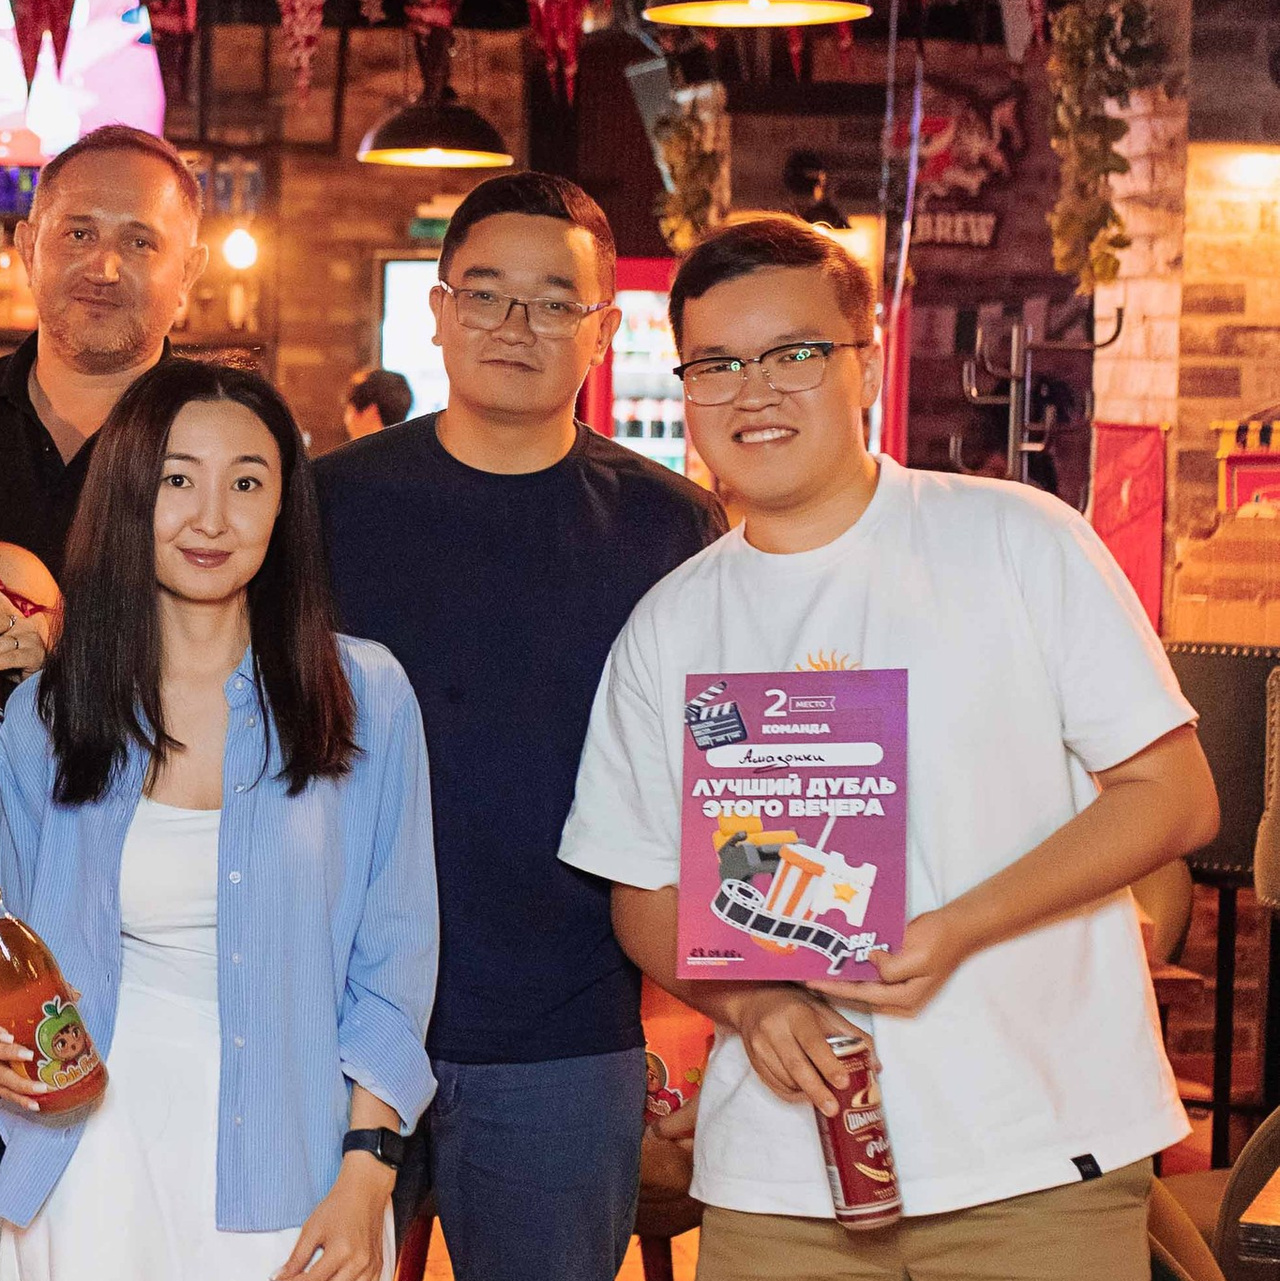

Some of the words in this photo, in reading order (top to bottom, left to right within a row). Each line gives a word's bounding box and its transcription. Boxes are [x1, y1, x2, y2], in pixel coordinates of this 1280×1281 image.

[764, 688, 788, 717] 2
[795, 700, 828, 708] МЕСТО
[761, 723, 831, 734] КОМАНДА
[691, 773, 802, 797] ЛУЧШИЙ
[805, 777, 898, 799] ДУБЛЬ
[702, 799, 785, 818] ЭТОГО
[788, 798, 886, 817] ВЕЧЕРА
